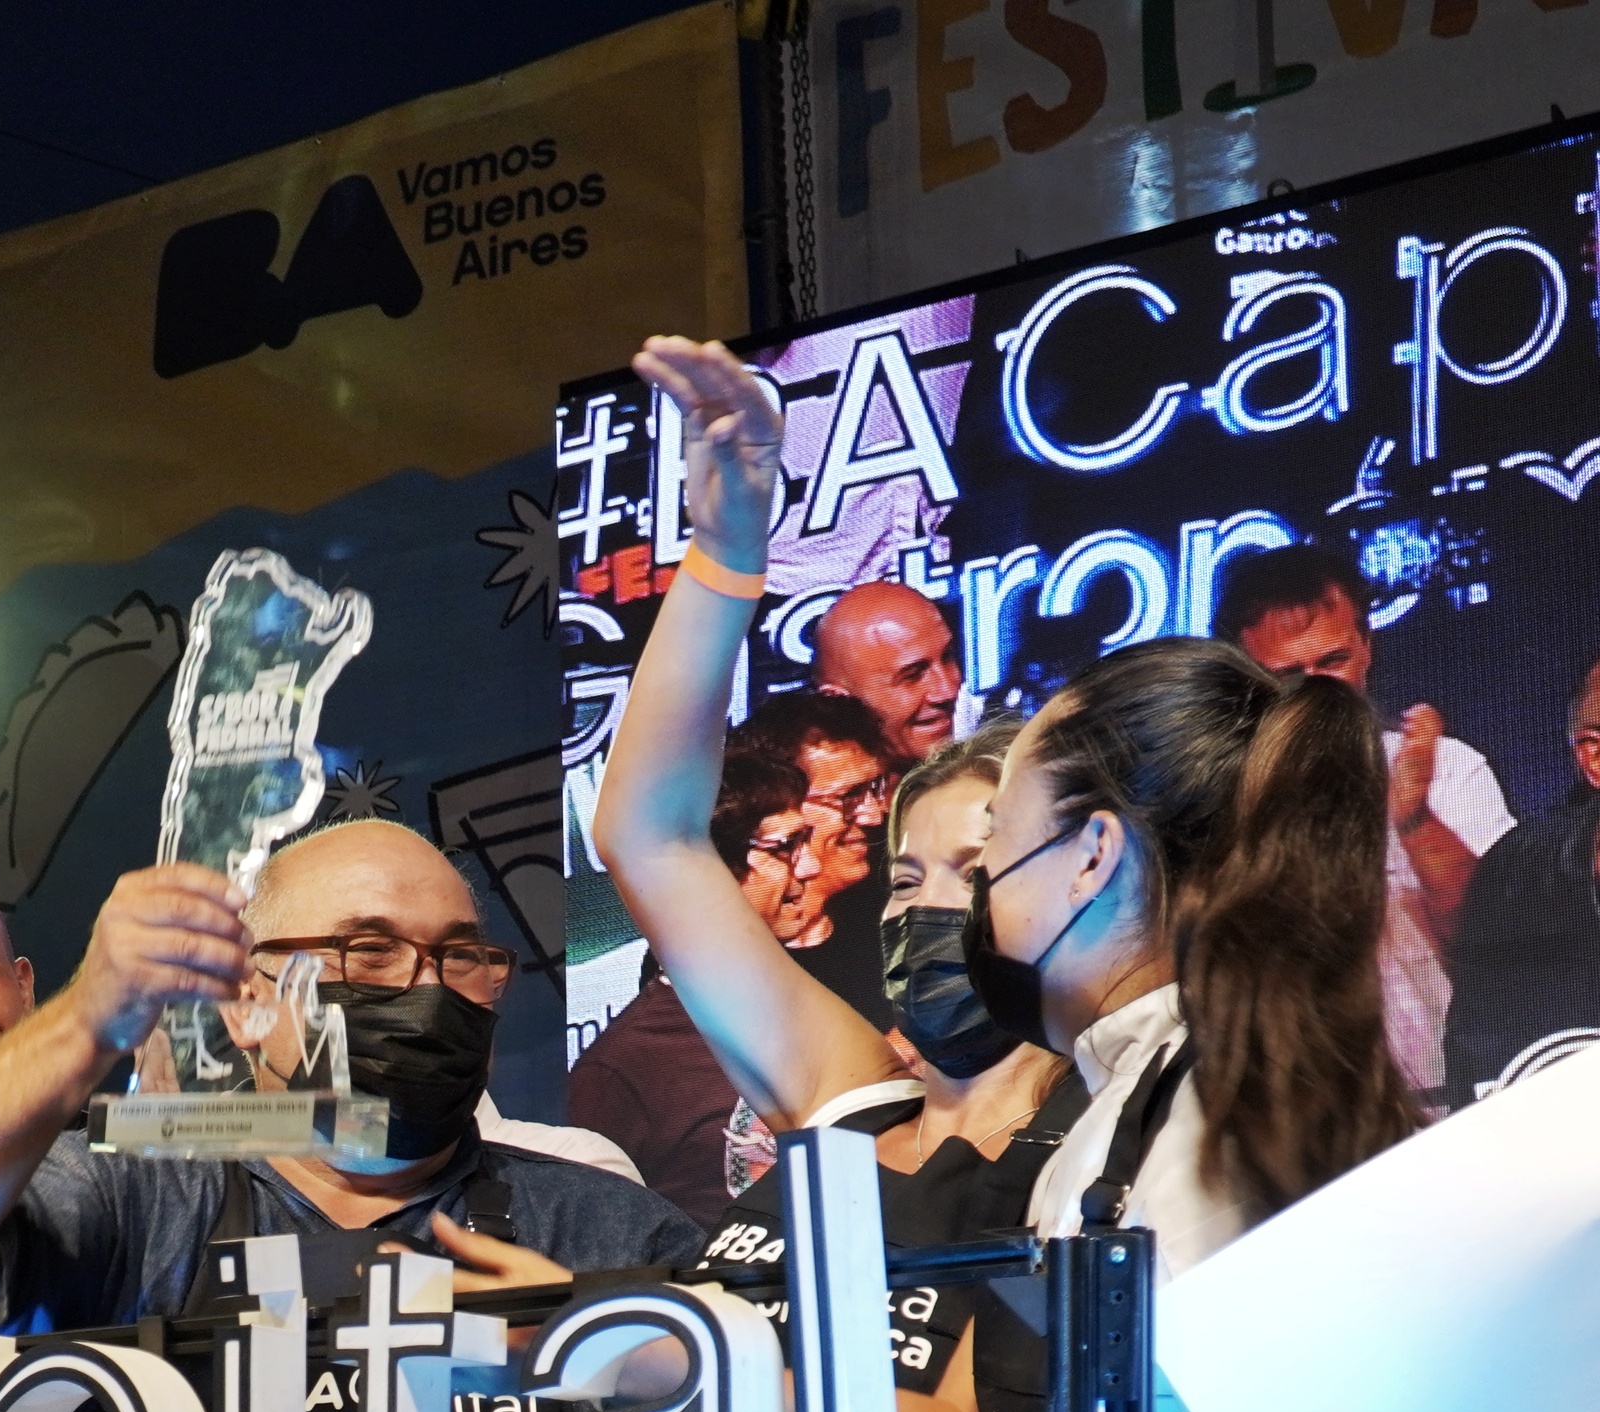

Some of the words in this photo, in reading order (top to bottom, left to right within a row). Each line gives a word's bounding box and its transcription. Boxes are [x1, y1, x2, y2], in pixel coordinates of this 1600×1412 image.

[397, 138, 557, 205] Vamos
[424, 173, 606, 244] Buenos
[154, 174, 423, 379] BA
[452, 225, 588, 286] Aires
